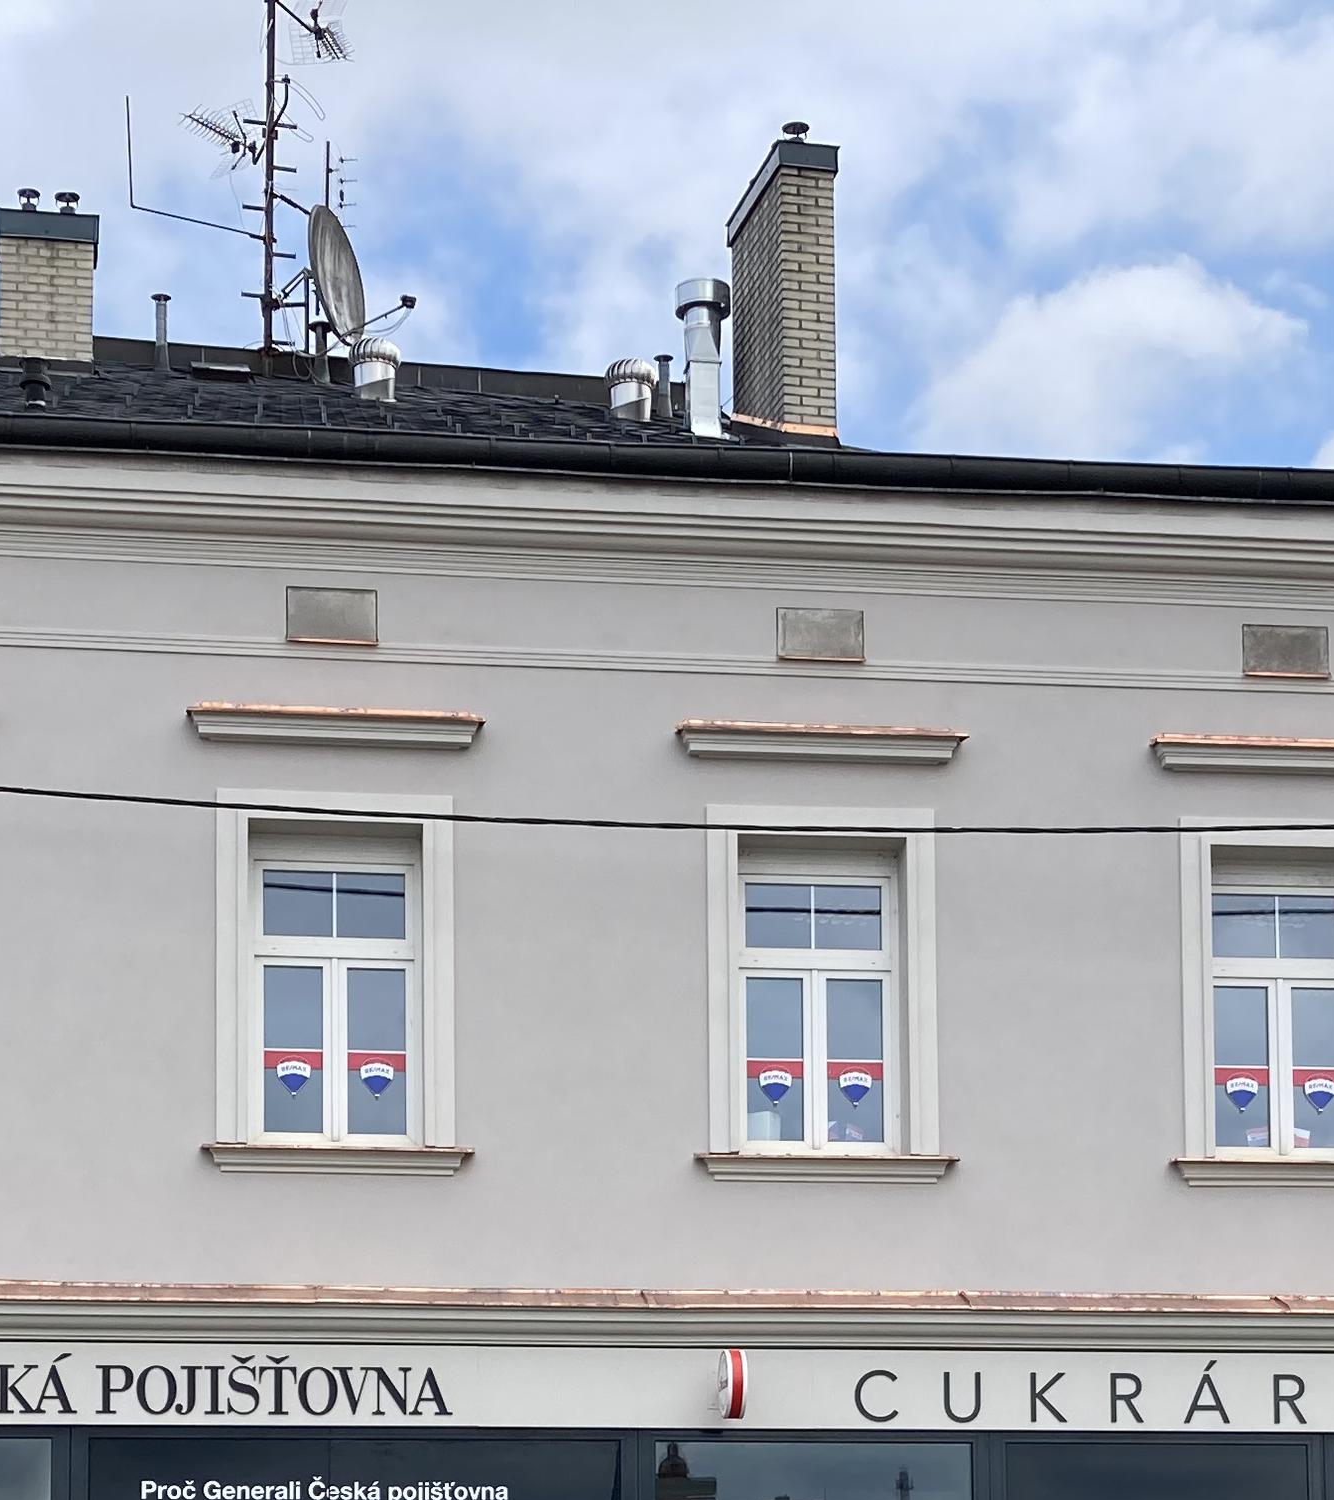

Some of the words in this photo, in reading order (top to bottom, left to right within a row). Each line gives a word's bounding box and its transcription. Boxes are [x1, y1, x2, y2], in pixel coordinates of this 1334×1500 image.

[280, 1064, 307, 1073] RE/MAX
[364, 1066, 390, 1075] RE/MAX
[763, 1073, 788, 1082] RE/MAX
[843, 1075, 868, 1083] RE/MAX
[1230, 1081, 1255, 1089] RE/MAX
[1308, 1082, 1333, 1091] RE/MAX
[95, 1354, 454, 1417] POJIŠŤOVNA
[140, 1480, 197, 1500] Proč
[203, 1480, 301, 1500] Generali
[307, 1477, 381, 1500] Česká
